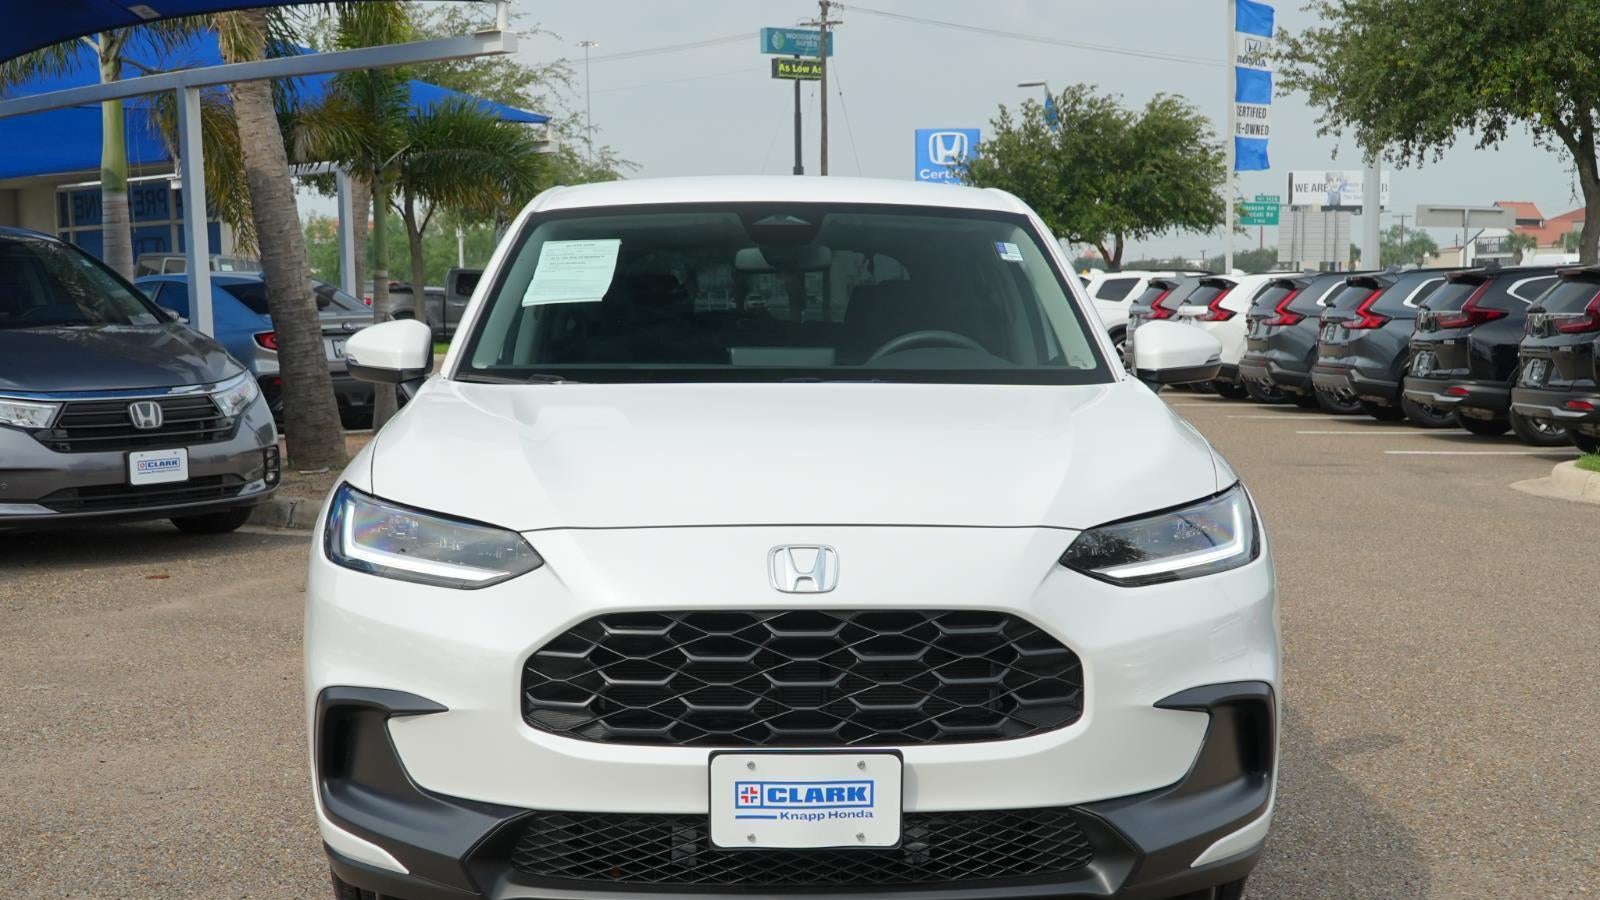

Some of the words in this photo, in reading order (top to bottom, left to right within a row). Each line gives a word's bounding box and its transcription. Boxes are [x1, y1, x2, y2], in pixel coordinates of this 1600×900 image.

[779, 64, 790, 72] As
[792, 65, 809, 73] Low
[1295, 183, 1309, 193] WE
[1311, 183, 1329, 193] ARE
[767, 786, 867, 803] CLARK
[780, 811, 825, 822] Knapp
[828, 809, 874, 820] Honda
